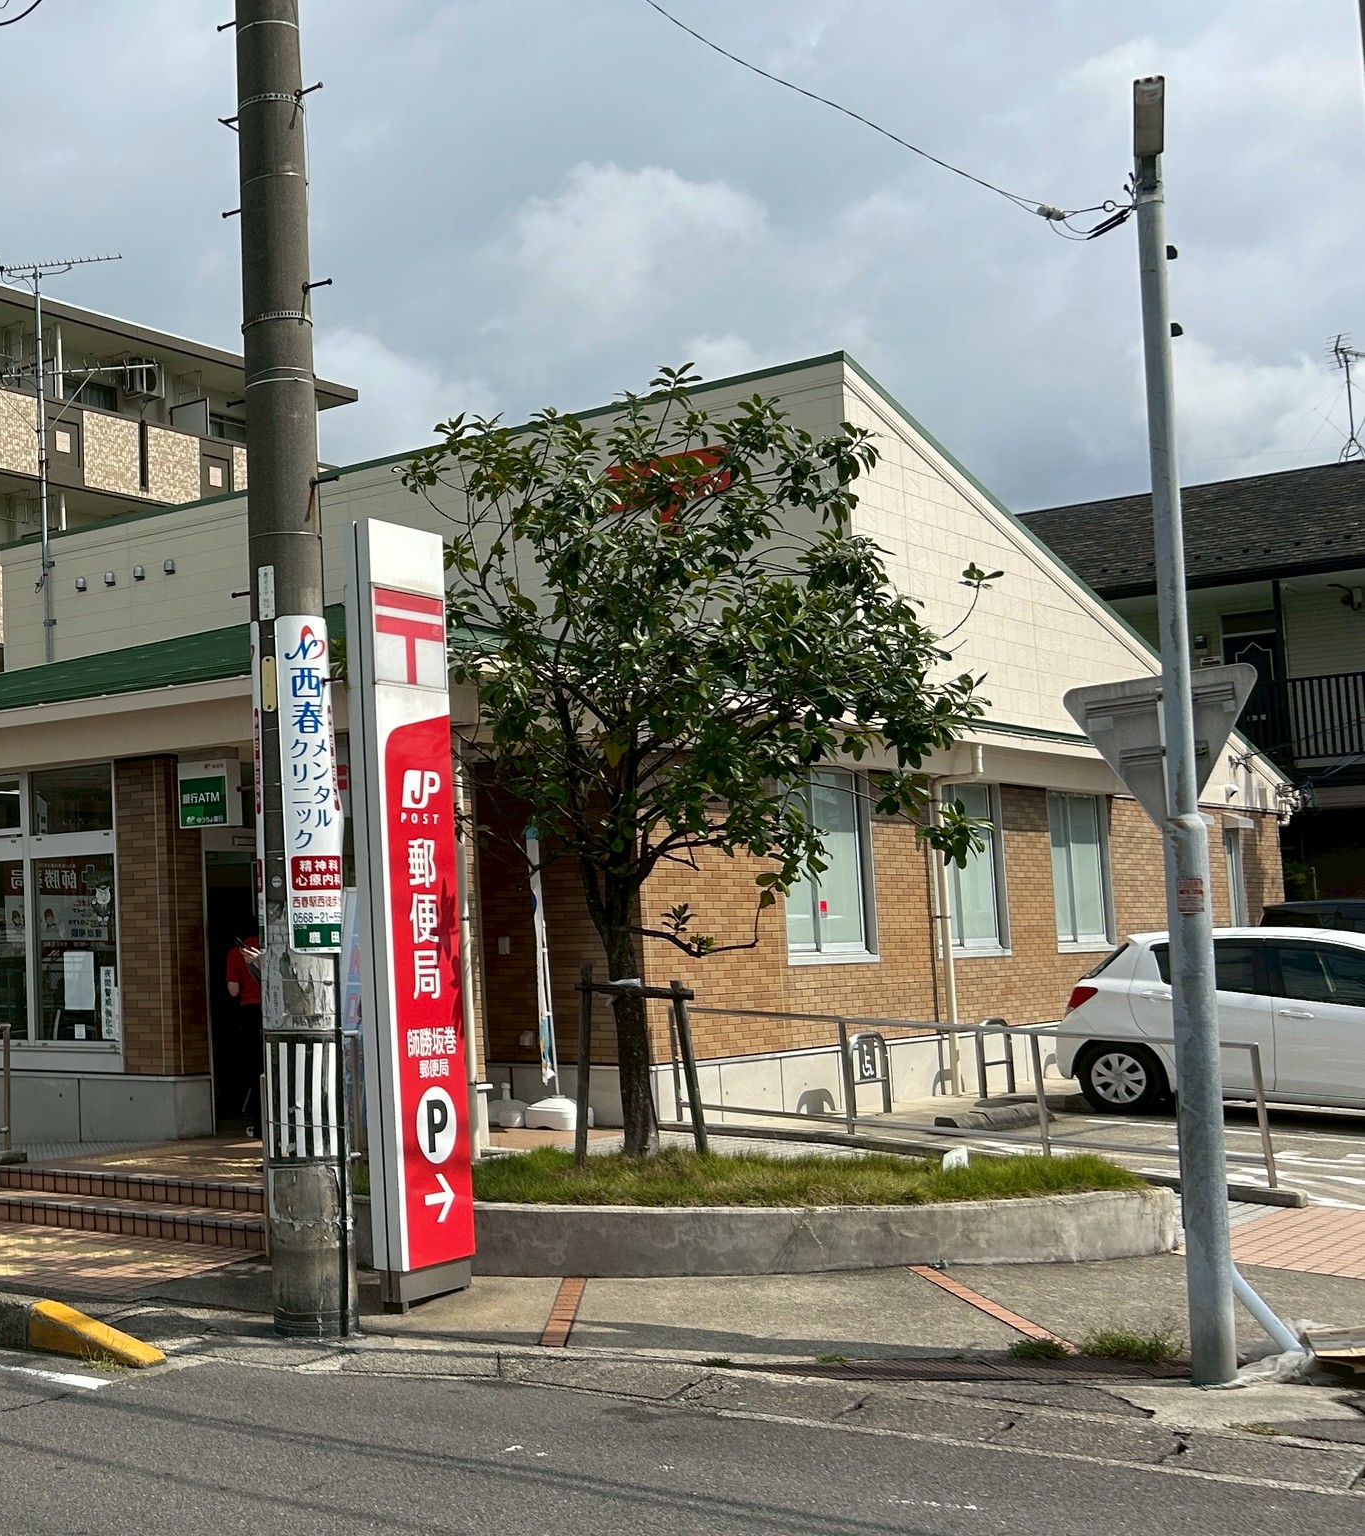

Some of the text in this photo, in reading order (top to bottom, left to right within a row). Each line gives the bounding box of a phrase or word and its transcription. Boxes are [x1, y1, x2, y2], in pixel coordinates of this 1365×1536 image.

[291, 667, 323, 734] 西春
[182, 792, 220, 804] 銀行ATM
[290, 740, 313, 849] クリニック
[313, 738, 332, 828] メンタル
[401, 812, 439, 825] POST
[299, 860, 338, 872] 精神科
[408, 838, 442, 1000] 郵便局
[407, 1026, 457, 1056] 師勝坂巻
[419, 1059, 449, 1078] 郵便局
[427, 1098, 448, 1153] P
